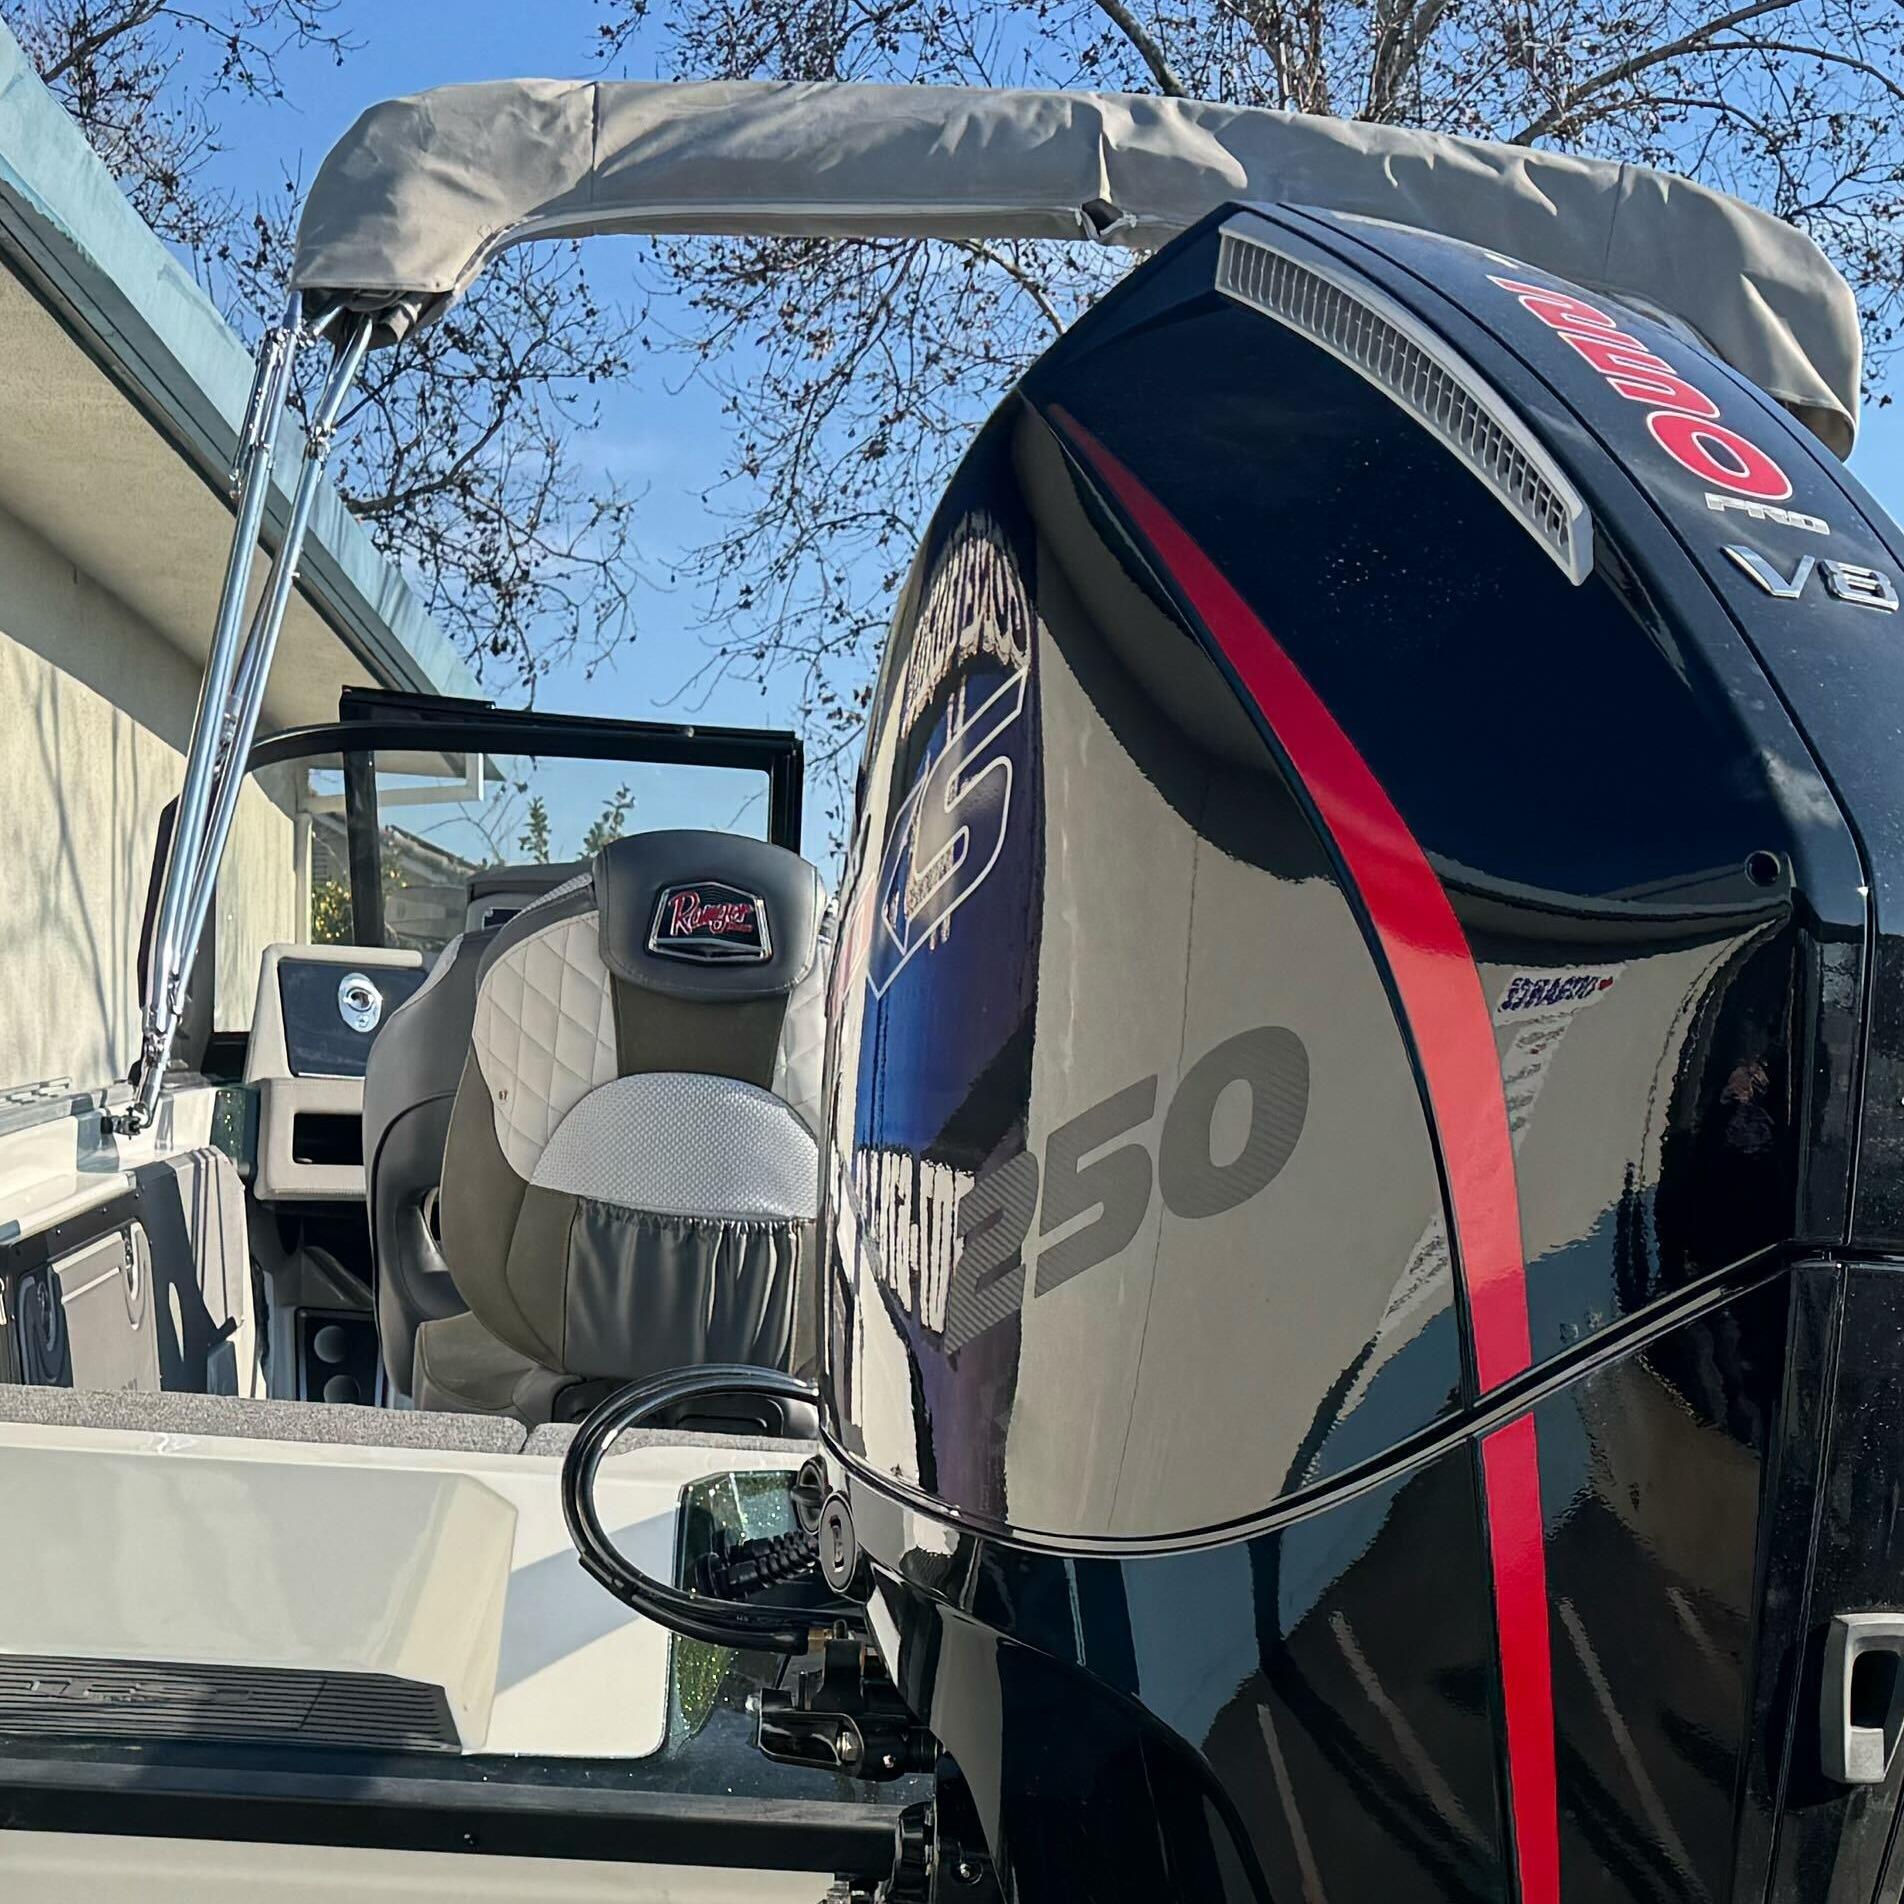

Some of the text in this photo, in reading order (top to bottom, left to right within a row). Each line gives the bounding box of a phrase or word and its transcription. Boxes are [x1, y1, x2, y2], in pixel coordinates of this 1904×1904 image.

[1704, 492, 1831, 536] PRO
[1719, 543, 1900, 615] V8
[668, 890, 754, 935] Ranger
[944, 1024, 1310, 1356] 250
